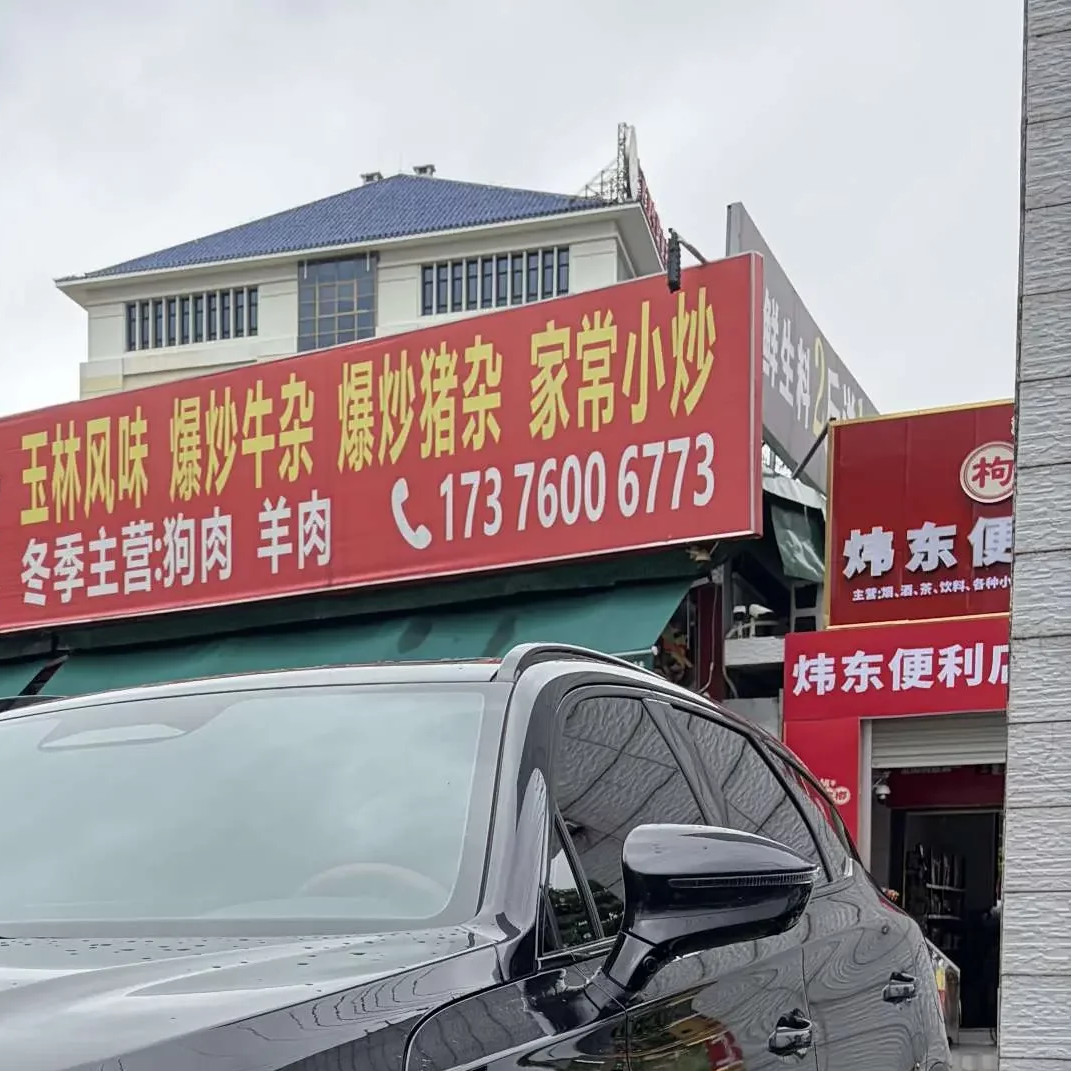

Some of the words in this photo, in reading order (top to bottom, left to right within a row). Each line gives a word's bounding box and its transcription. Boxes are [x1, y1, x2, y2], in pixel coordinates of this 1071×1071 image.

[20, 406, 148, 526] 玉林风味
[169, 373, 315, 501] 爆炒牛杂
[338, 335, 501, 473] 爆炒猪杂
[529, 287, 717, 440] 家常小炒
[258, 490, 331, 574] 羊肉
[440, 470, 501, 542] 173
[515, 451, 604, 531] 7600
[618, 432, 715, 517] 6773
